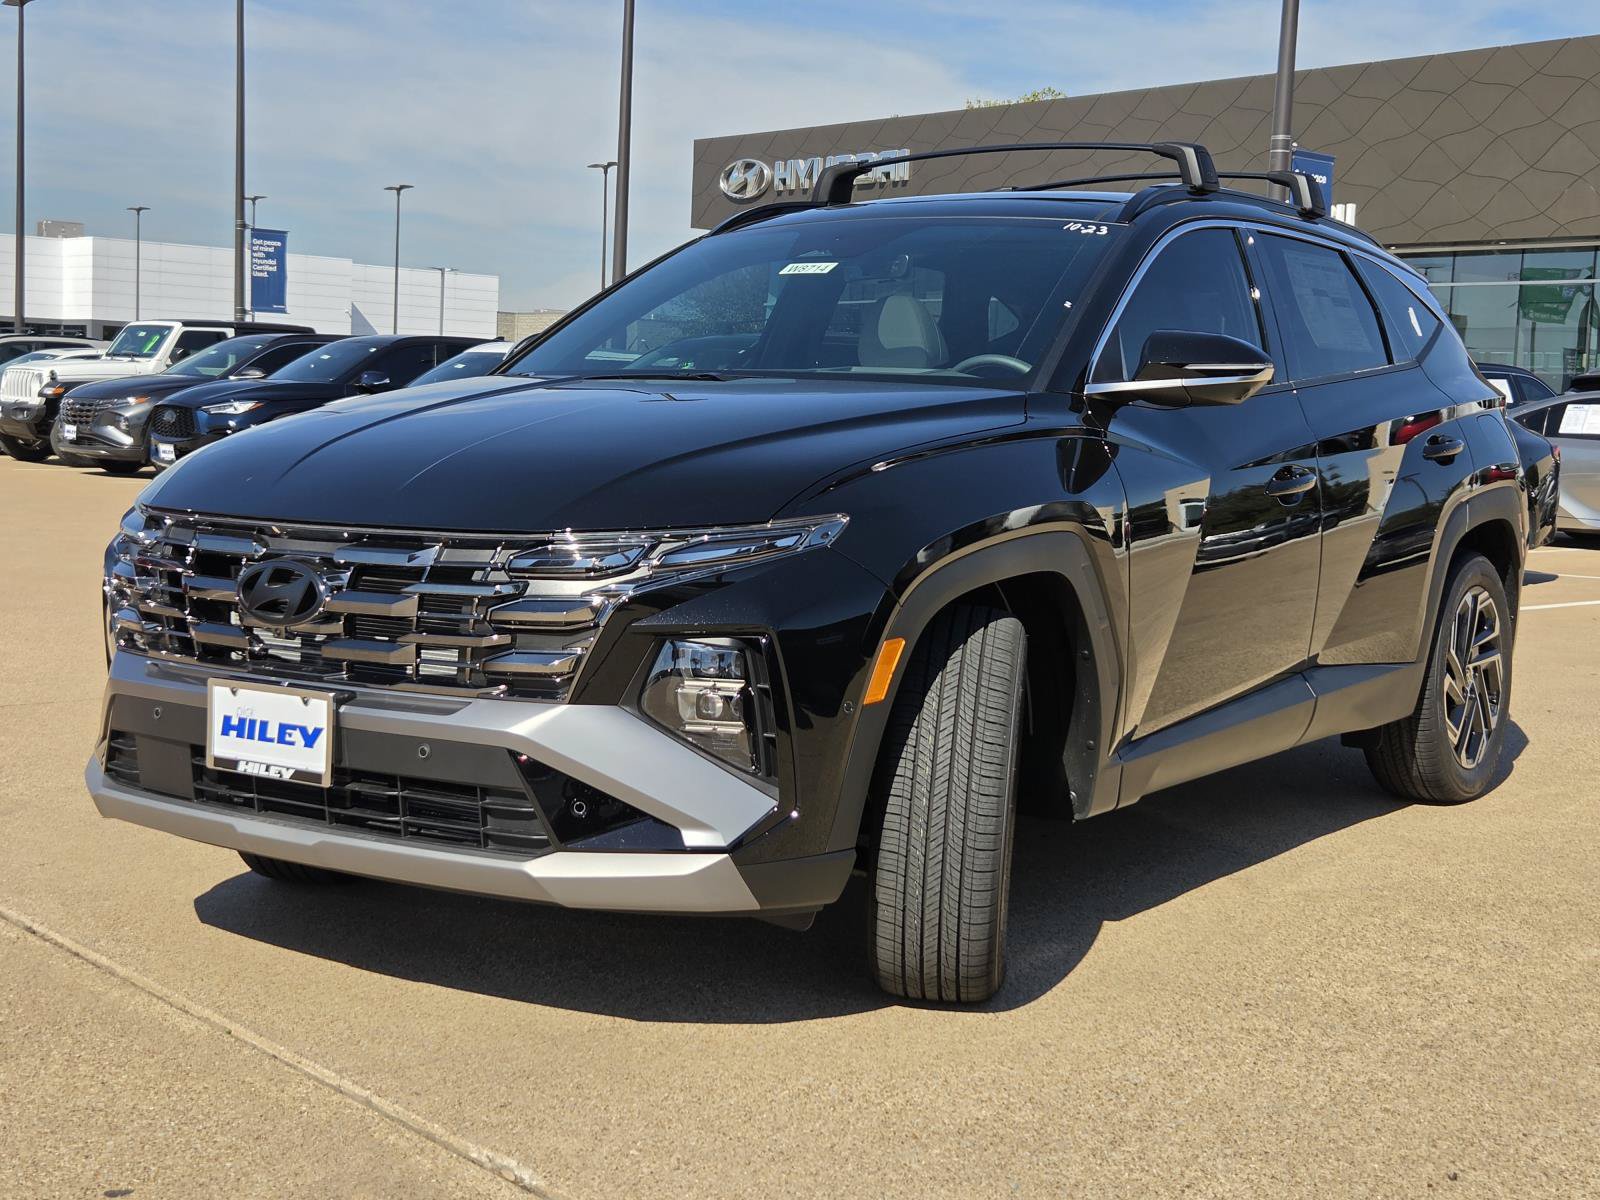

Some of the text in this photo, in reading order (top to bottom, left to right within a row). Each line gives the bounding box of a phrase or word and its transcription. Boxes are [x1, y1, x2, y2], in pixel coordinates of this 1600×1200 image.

[774, 149, 911, 191] HYDAI
[221, 715, 324, 748] HILEY
[237, 760, 296, 779] HILEY
